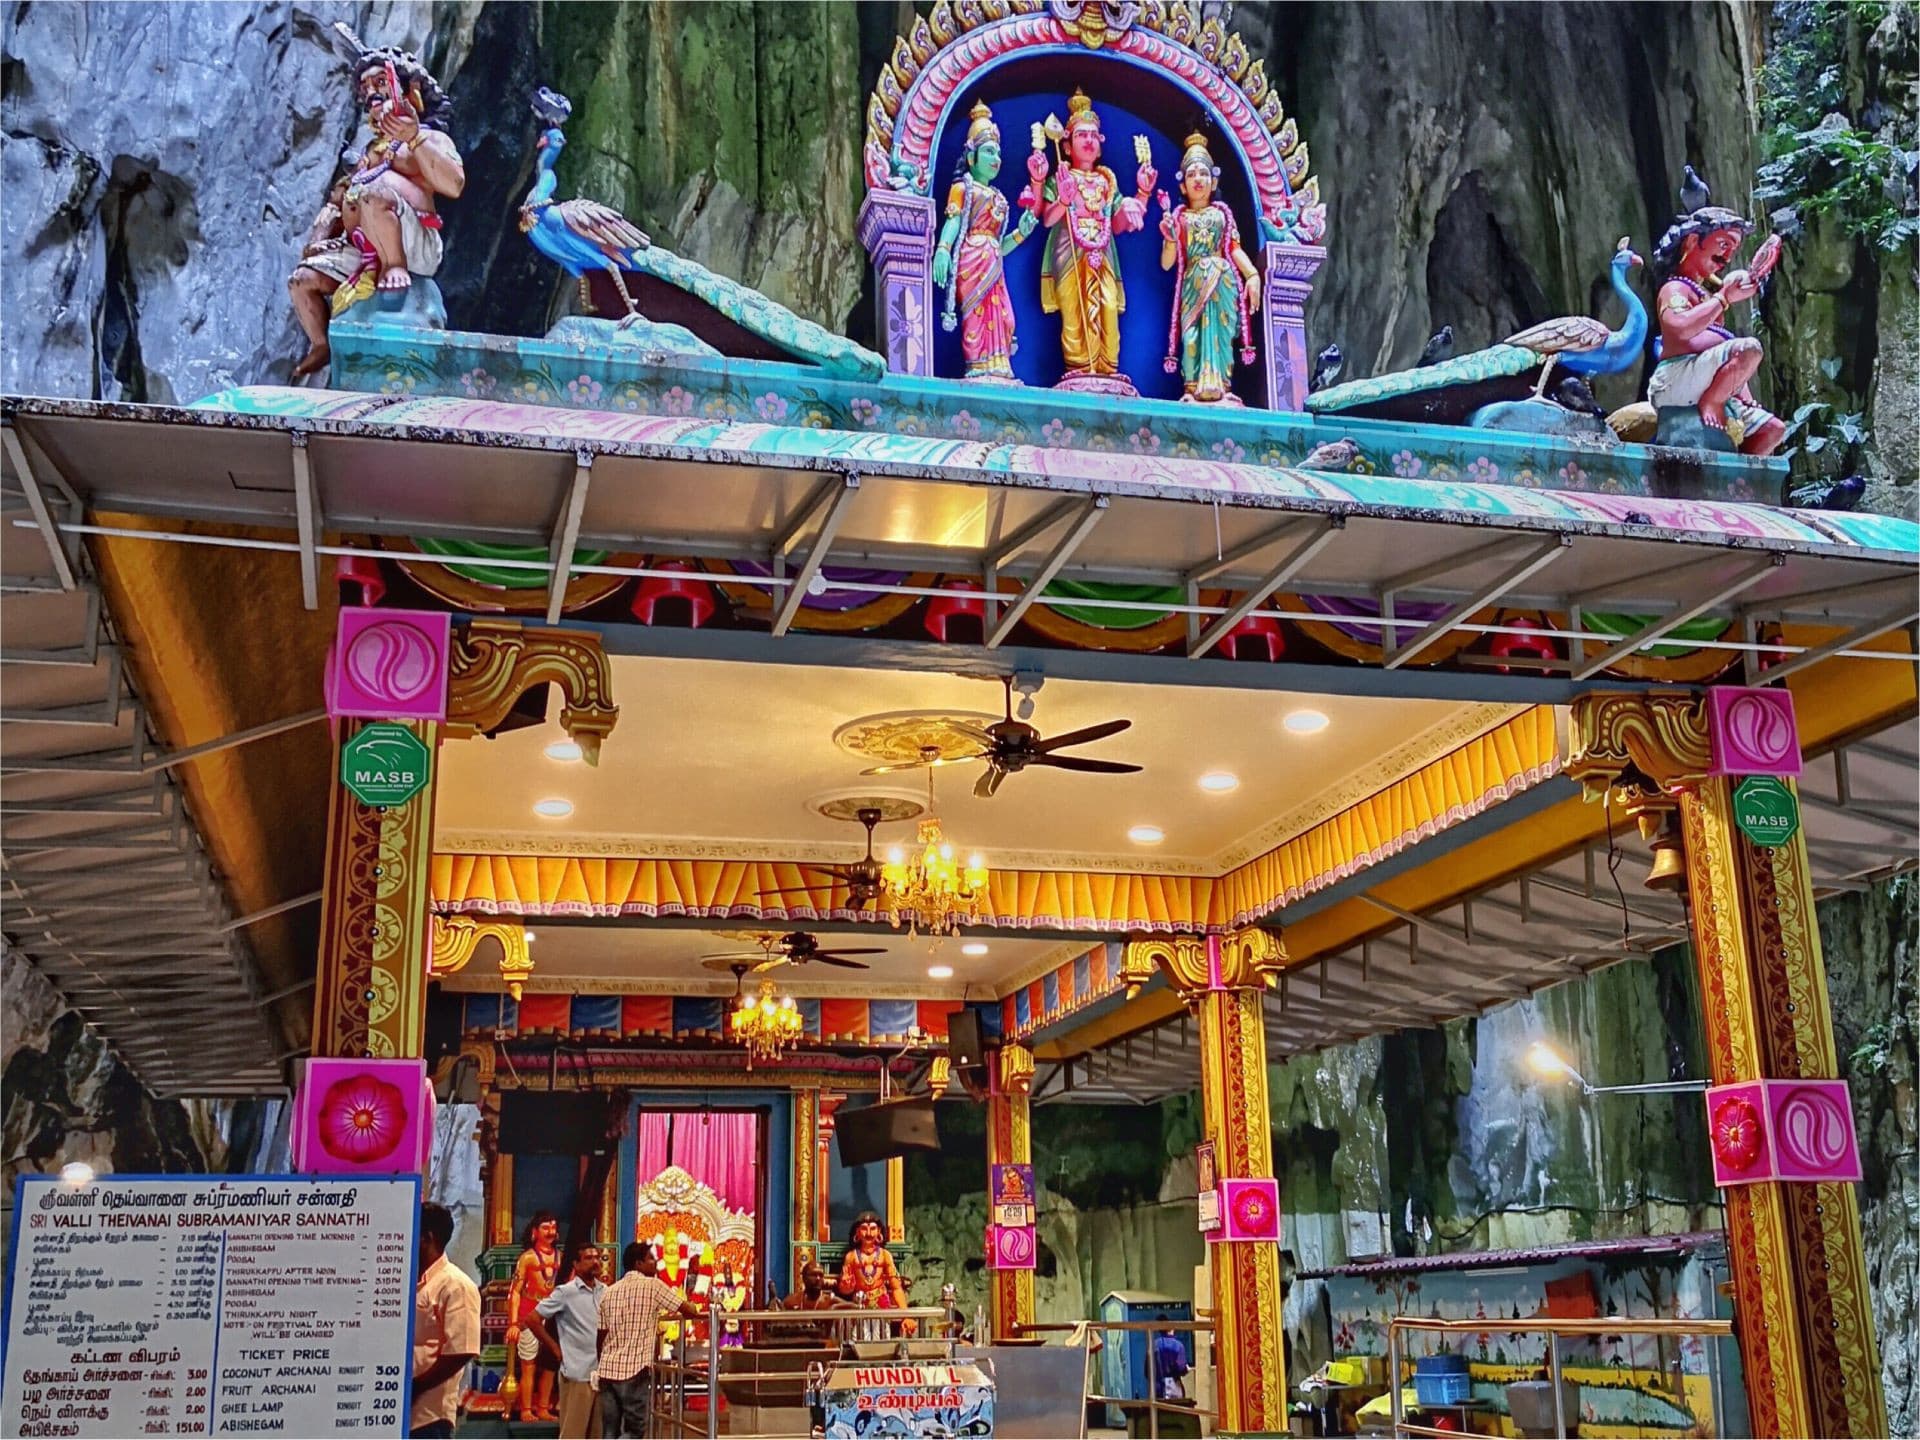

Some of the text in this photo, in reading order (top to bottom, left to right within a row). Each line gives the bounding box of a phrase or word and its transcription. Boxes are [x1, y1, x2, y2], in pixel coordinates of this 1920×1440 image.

[355, 771, 415, 783] MASB
[1745, 815, 1788, 826] MASB
[30, 1213, 370, 1228] SRI VALLI THEIVANAI SUBRAMANIYAR SANNATHI
[296, 1233, 317, 1241] TIME
[284, 1267, 313, 1275] AFTER
[289, 1310, 318, 1318] NIGHT
[223, 1321, 244, 1329] NOTE
[267, 1320, 312, 1329] FESTIVAL
[316, 1320, 335, 1328] DAY
[339, 1320, 361, 1328] TIME
[252, 1330, 335, 1339] WILL BE CHANGED
[70, 1347, 181, 1365] கட்டண விபரம்
[239, 1348, 330, 1360] TICKET PRICE
[187, 1369, 208, 1380] 3.00
[222, 1367, 272, 1379] COCONUT
[275, 1366, 332, 1377] ARCHANAI
[375, 1365, 400, 1376] 3.00
[855, 1367, 962, 1387] HUNDIYAL
[185, 1386, 207, 1397] 2.00
[222, 1384, 252, 1396] FRUIT
[261, 1383, 316, 1395] ARCHANAI
[374, 1381, 399, 1392] 2.00
[185, 1404, 206, 1414] 2.00
[221, 1402, 247, 1414] GHEE
[252, 1401, 284, 1413] LAMP
[373, 1398, 397, 1410] 2.00
[219, 1418, 285, 1432] ABISHEGAM
[363, 1414, 396, 1427] 151.00
